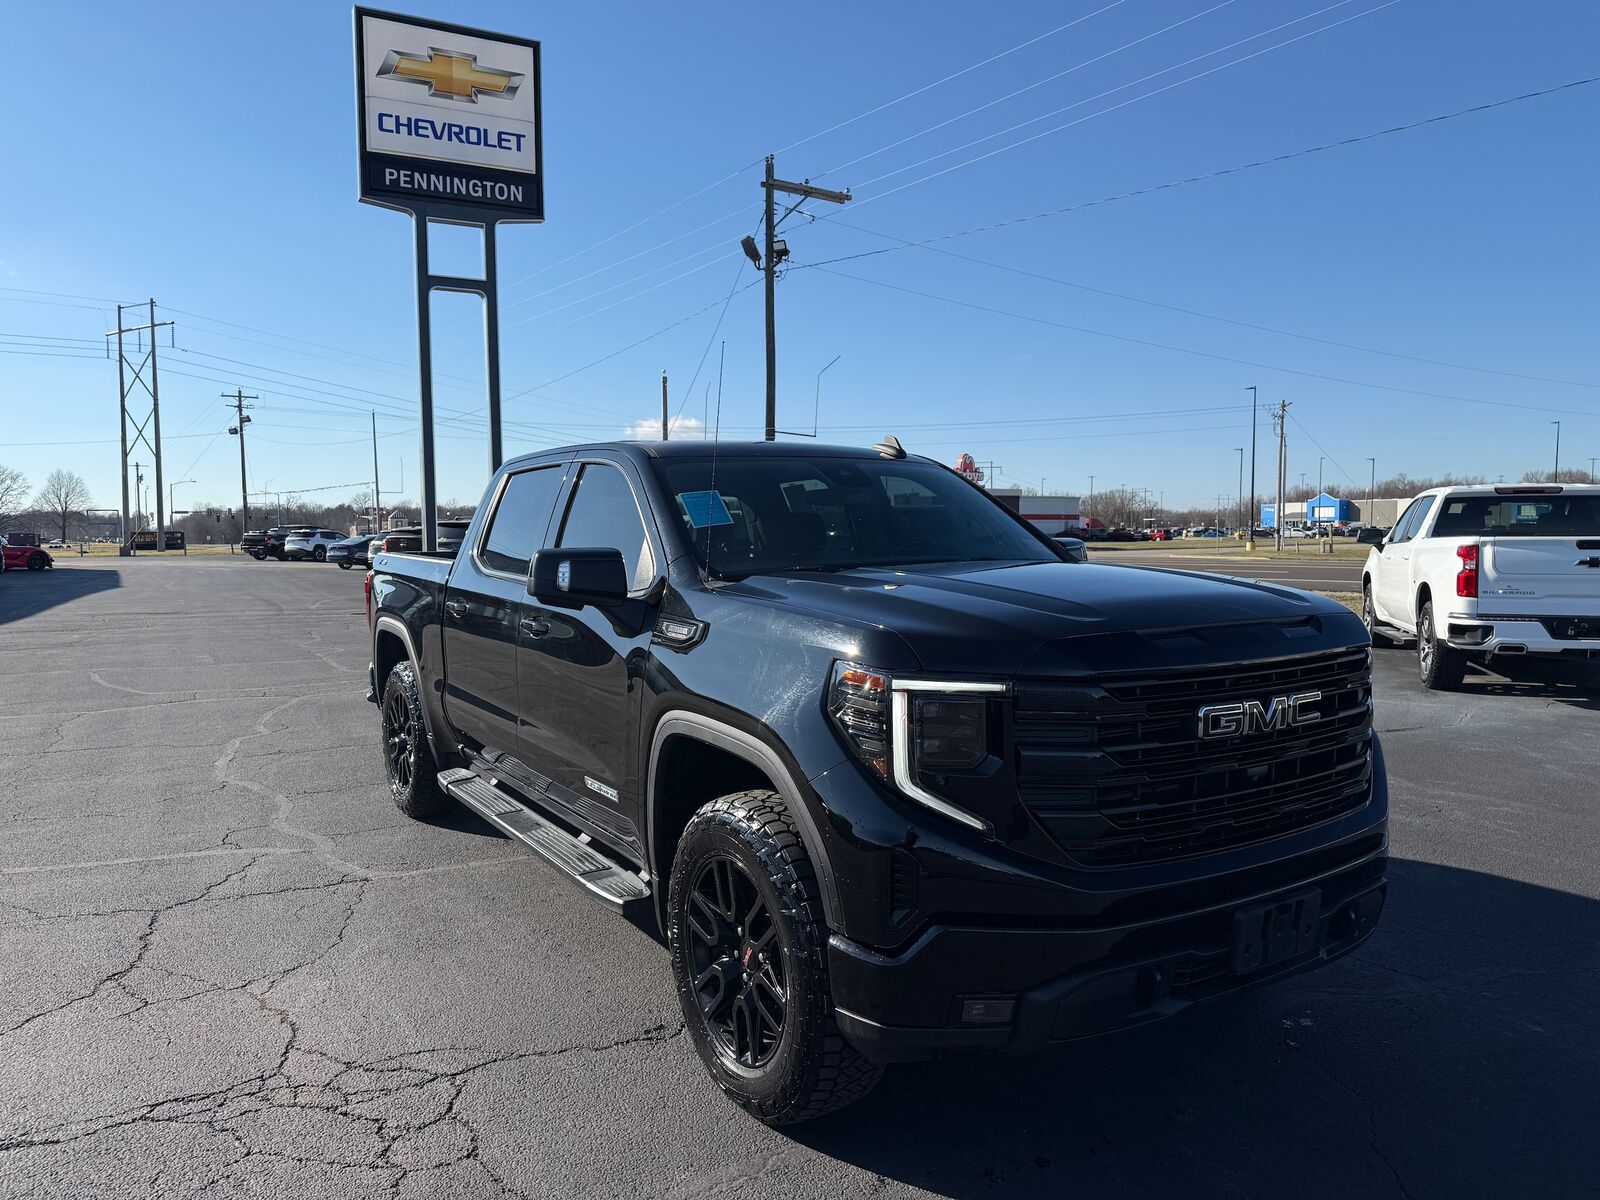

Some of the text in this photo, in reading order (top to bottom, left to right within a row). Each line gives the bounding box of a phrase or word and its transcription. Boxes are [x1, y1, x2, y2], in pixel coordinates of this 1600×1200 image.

[378, 112, 526, 152] CHEVROLET
[385, 168, 523, 202] PENNINGTON
[1197, 691, 1322, 739] GMC
